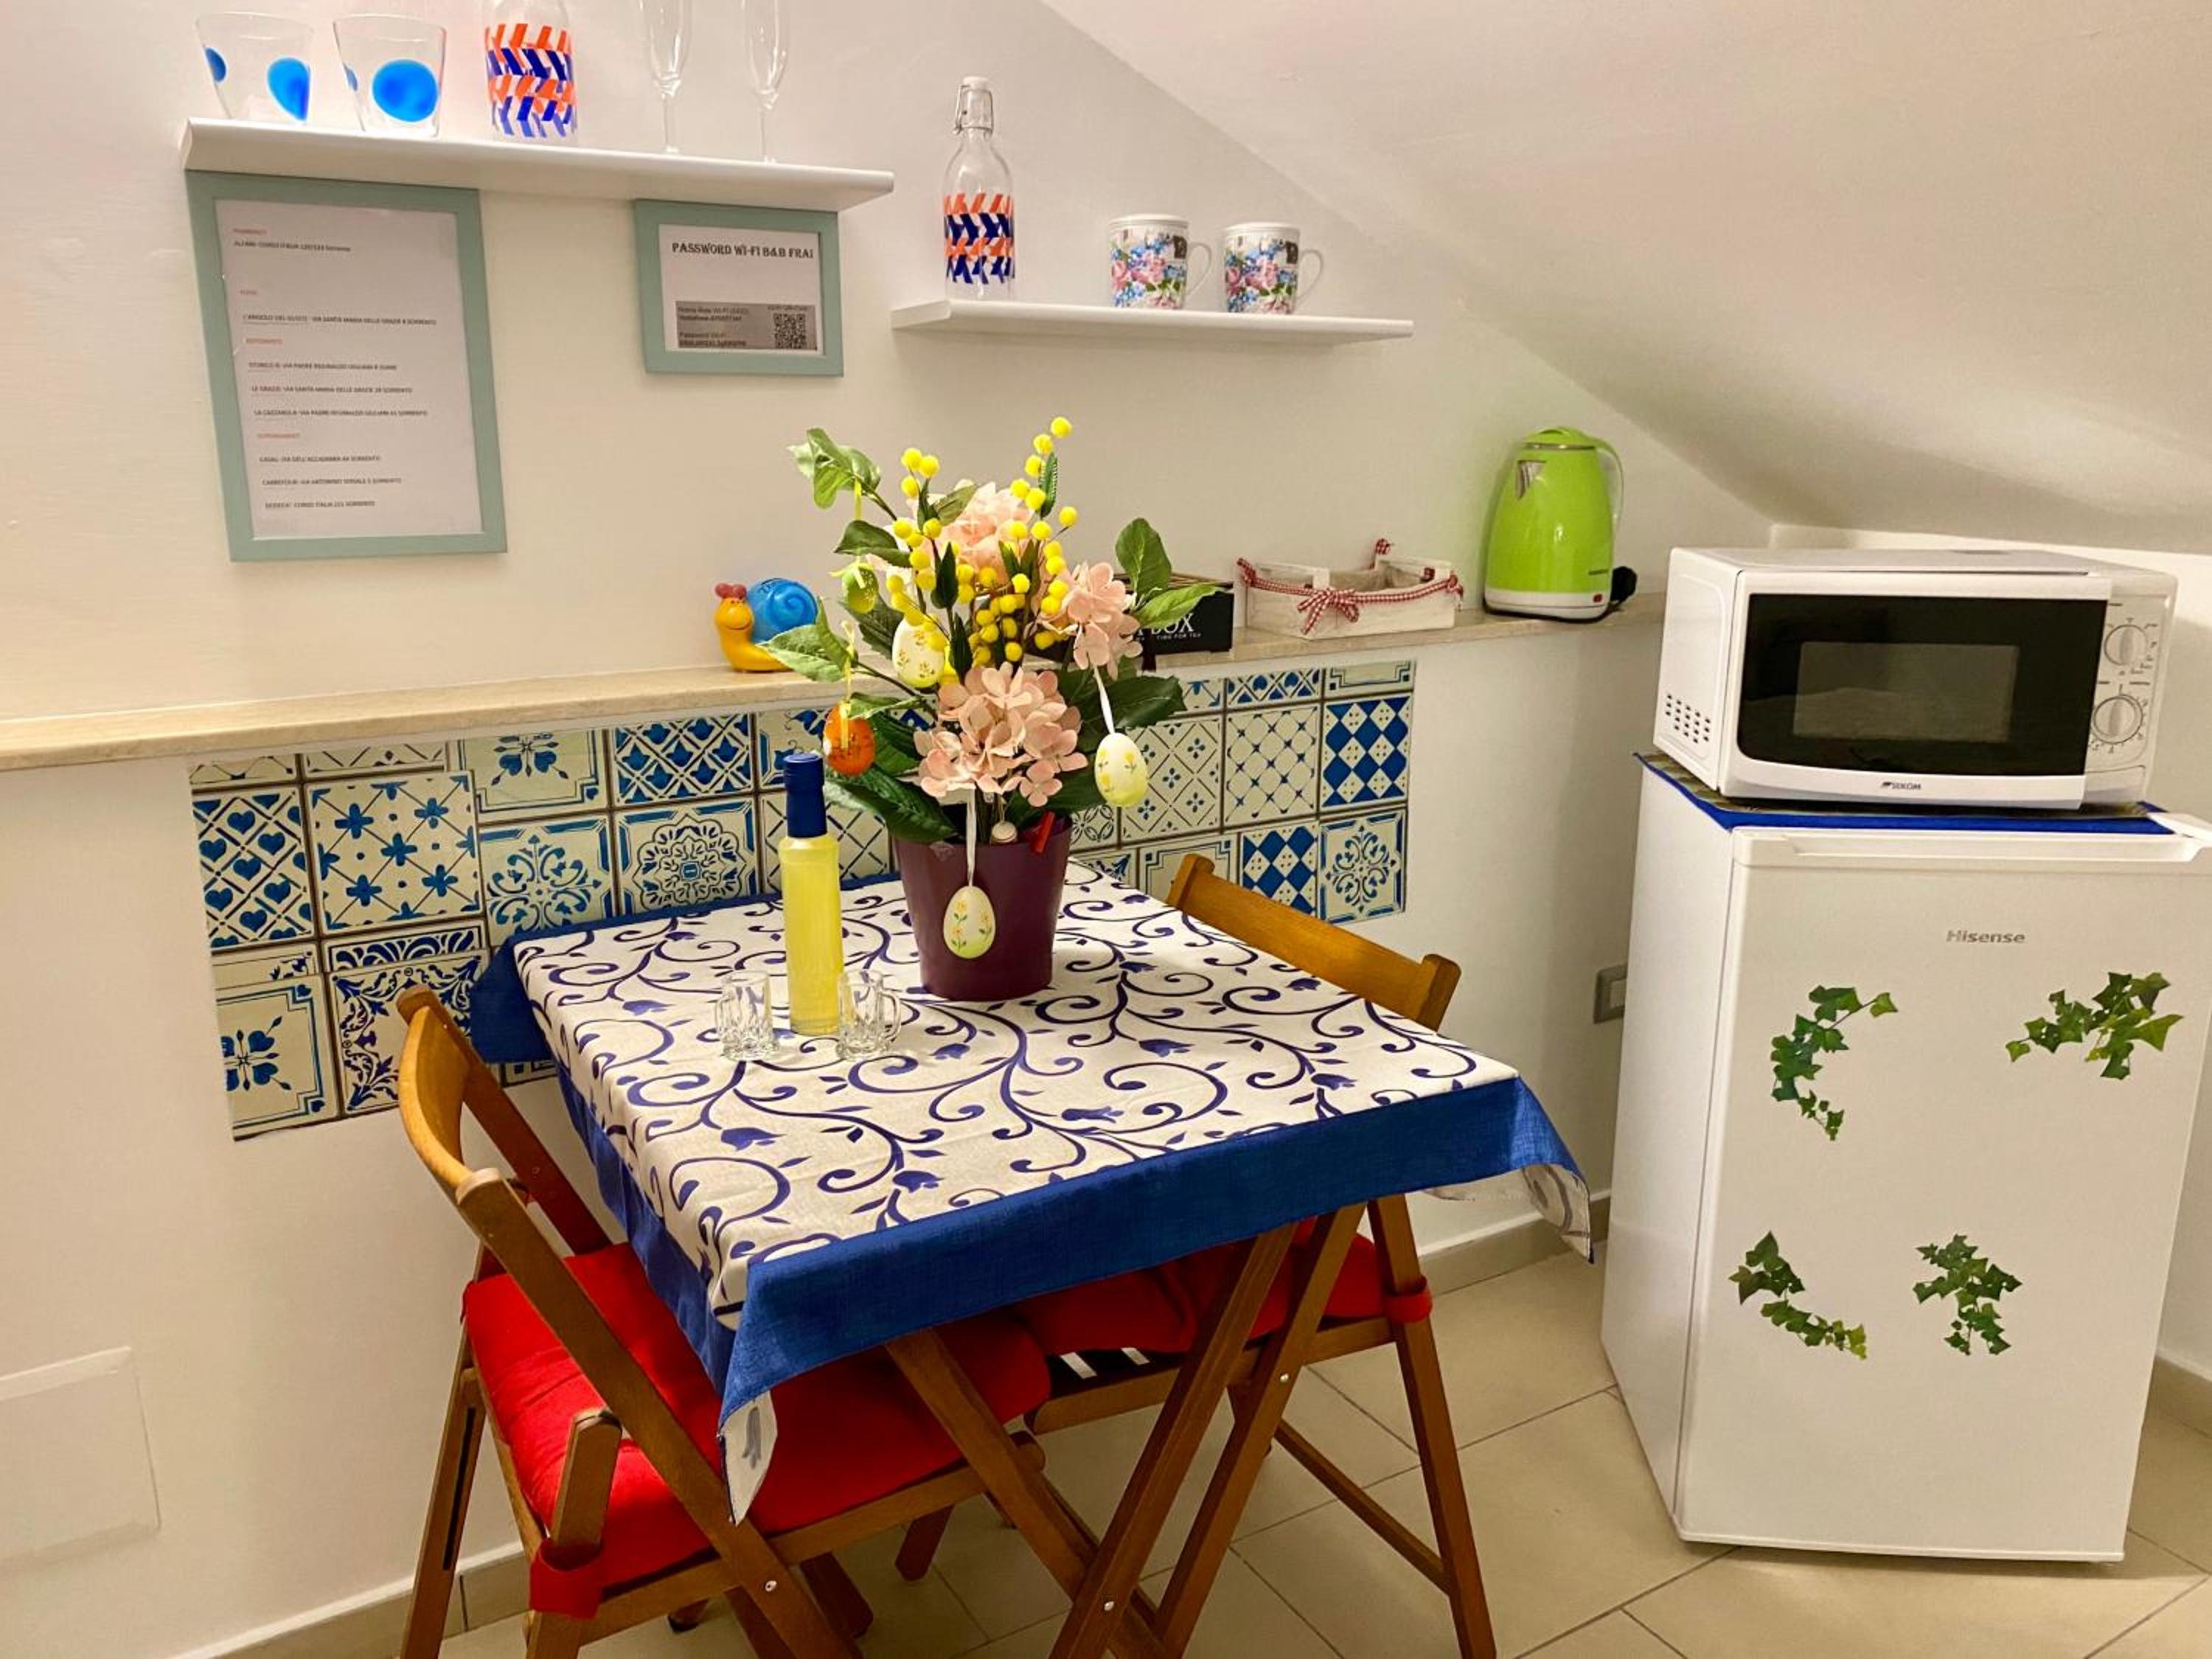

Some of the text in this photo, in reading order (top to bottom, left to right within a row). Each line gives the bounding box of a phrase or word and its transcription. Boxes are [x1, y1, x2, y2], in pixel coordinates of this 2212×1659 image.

[672, 243, 731, 254] PASSWORD
[734, 245, 760, 256] WI-FI
[762, 247, 786, 257] B&B
[1947, 929, 2026, 944] Hisense
